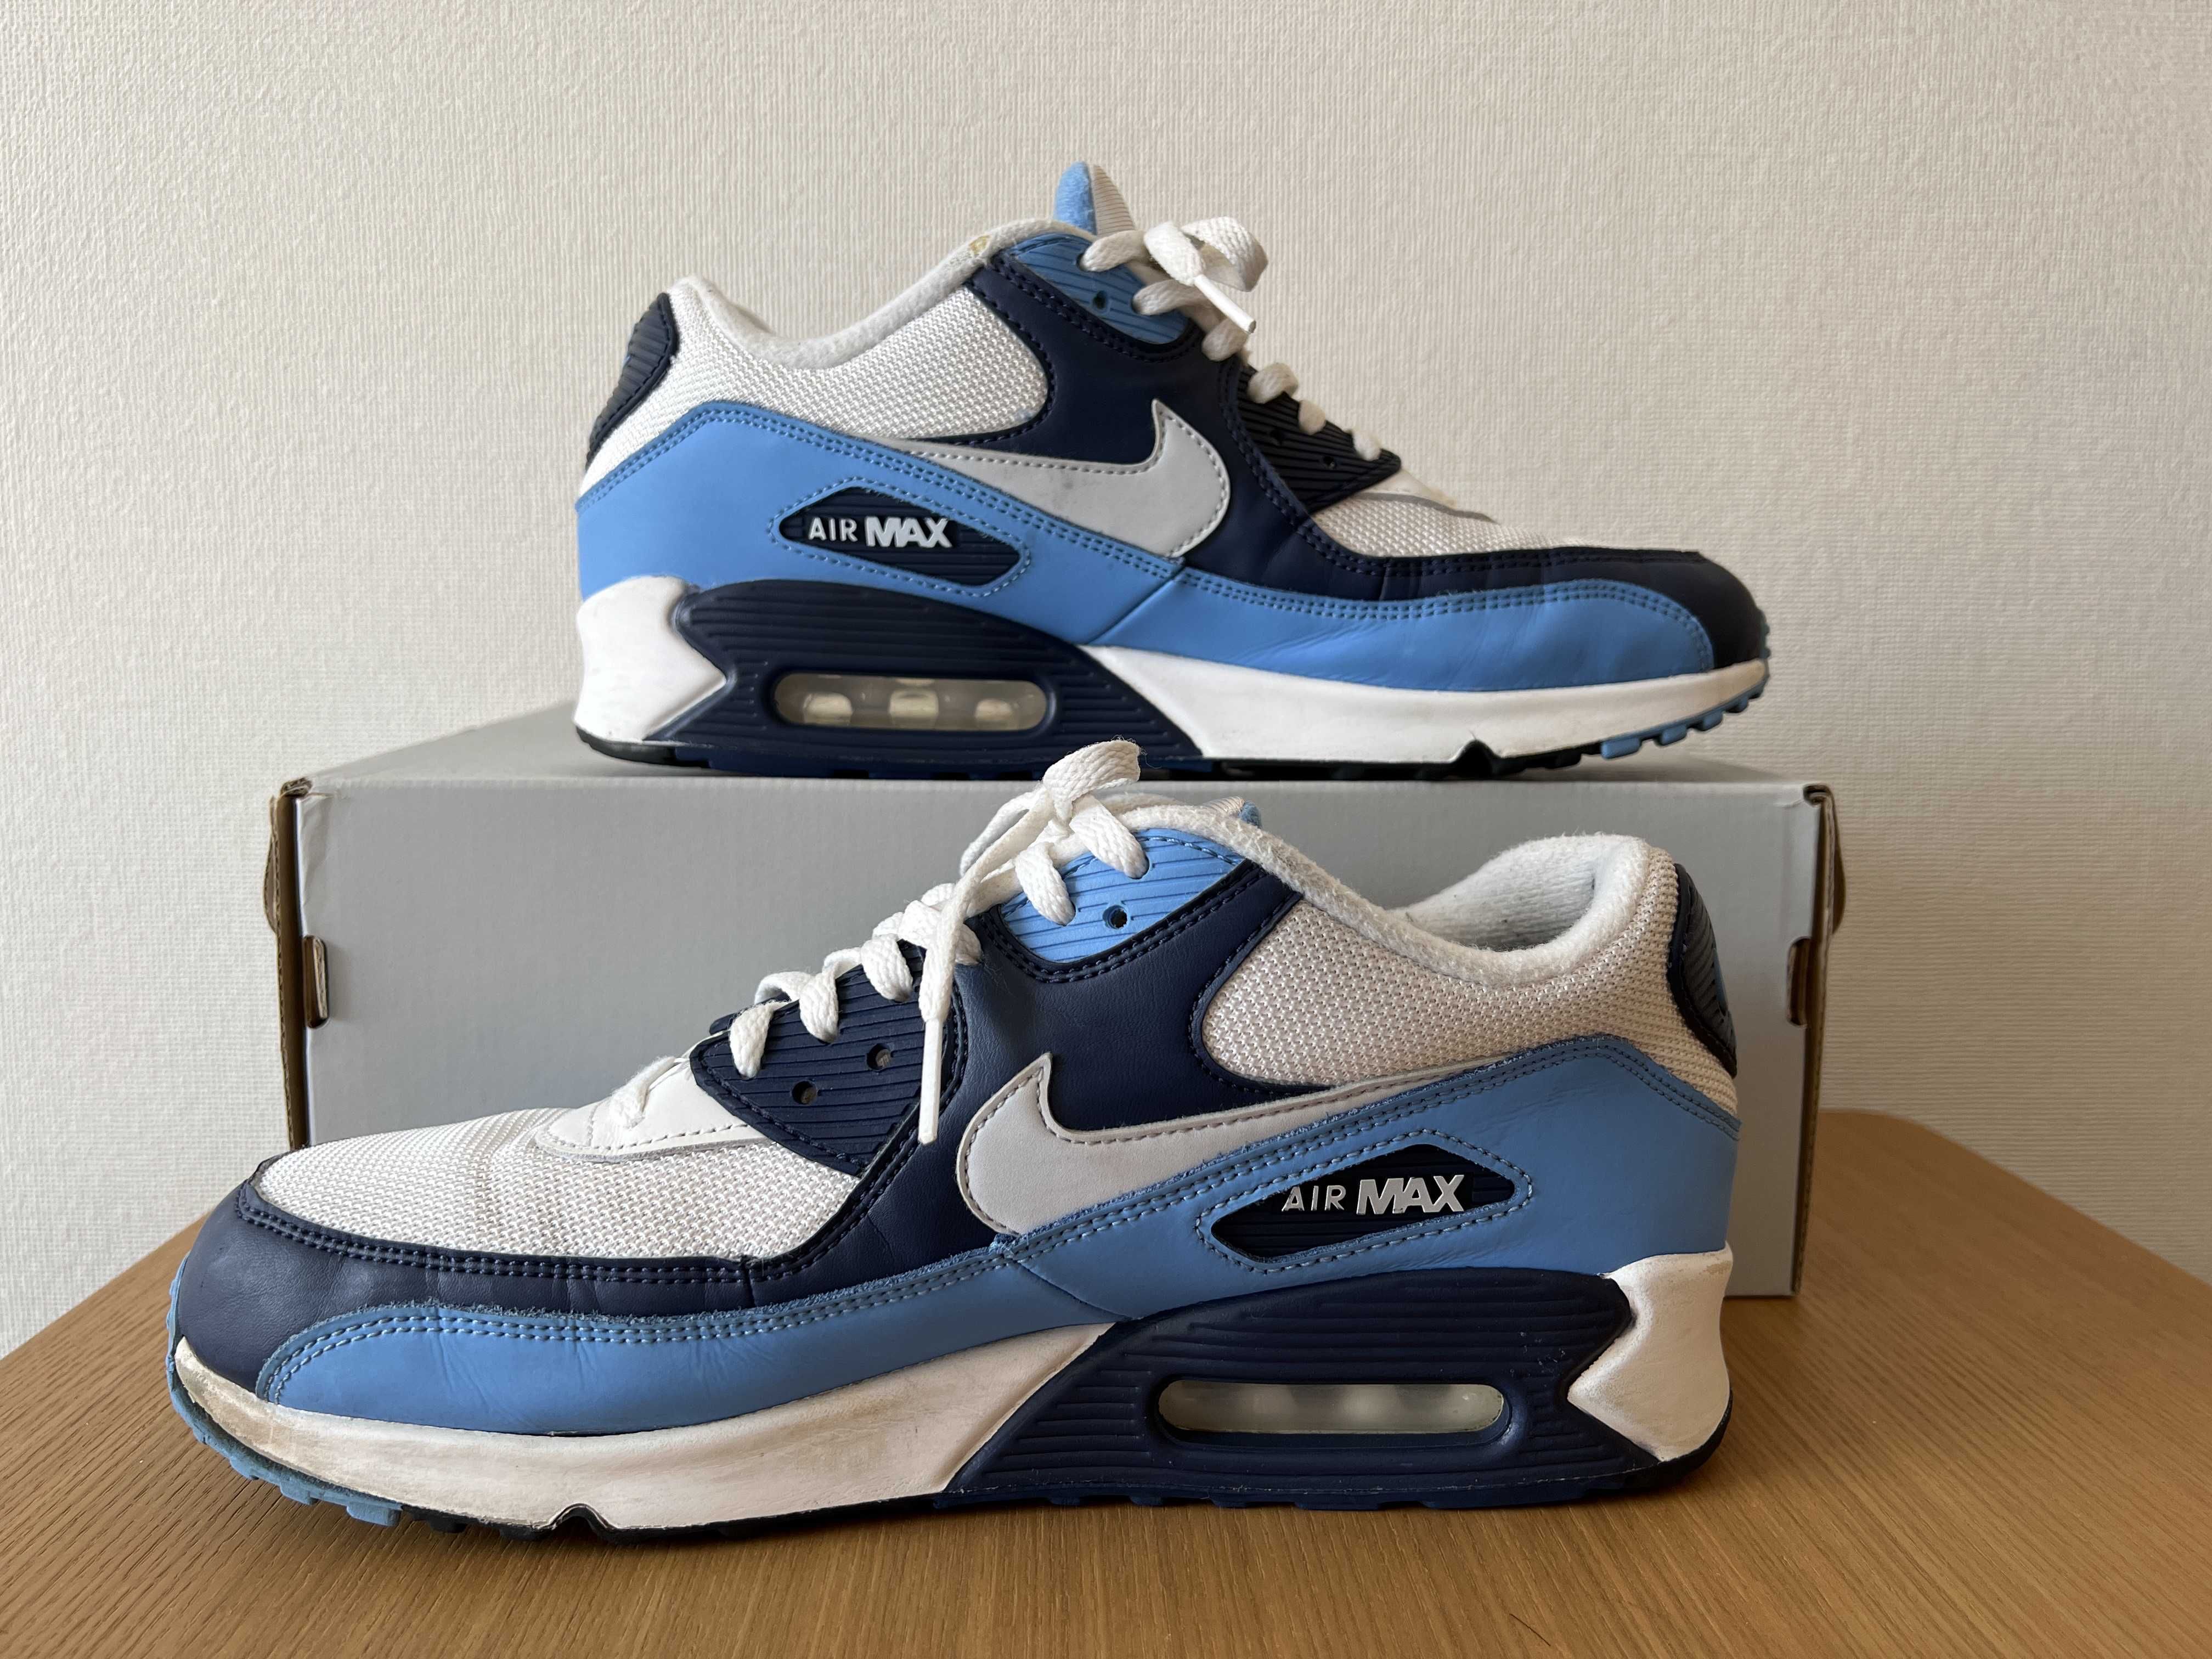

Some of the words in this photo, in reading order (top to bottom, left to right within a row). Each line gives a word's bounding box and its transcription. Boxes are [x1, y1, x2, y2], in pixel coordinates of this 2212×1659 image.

[808, 517, 858, 542] AIR
[865, 516, 952, 548] MAX
[1281, 1184, 1346, 1212] AIR
[1356, 1175, 1464, 1215] MAX
